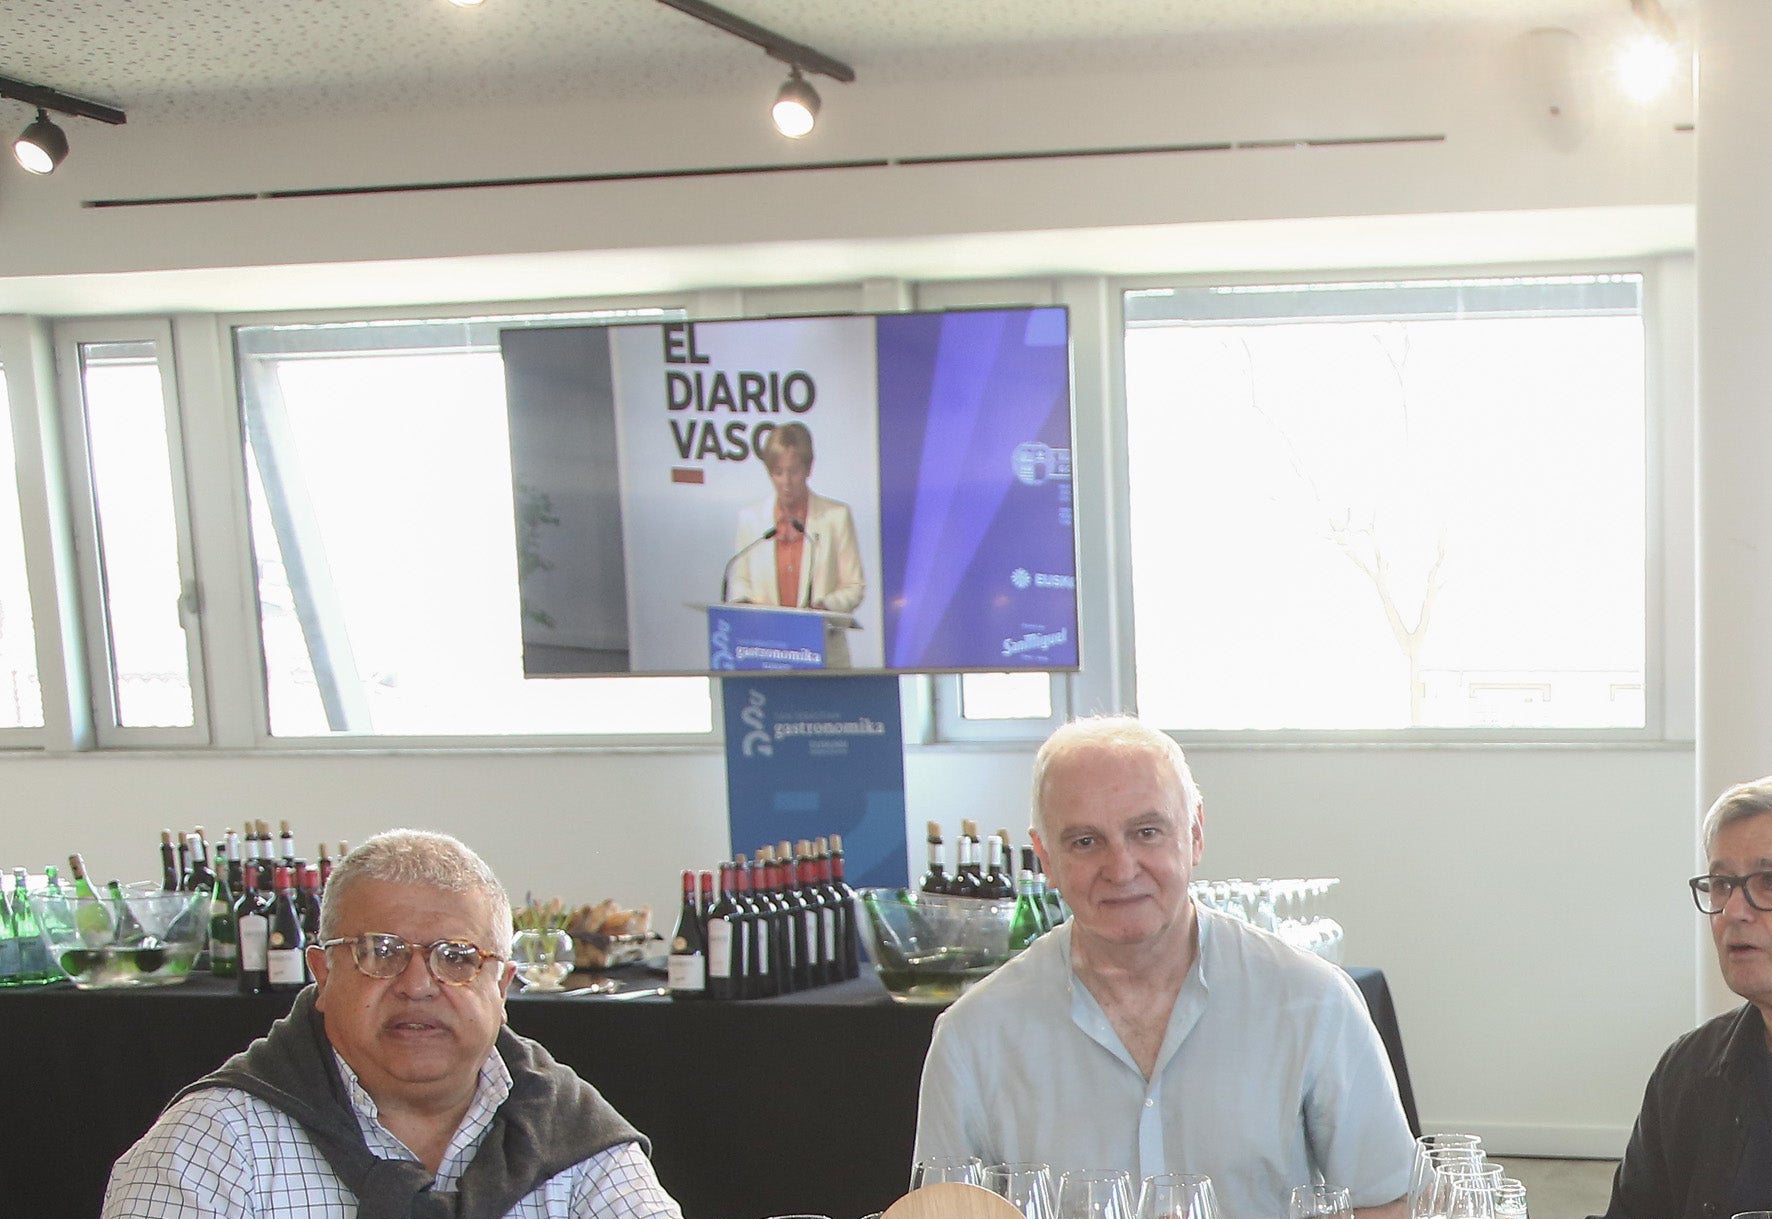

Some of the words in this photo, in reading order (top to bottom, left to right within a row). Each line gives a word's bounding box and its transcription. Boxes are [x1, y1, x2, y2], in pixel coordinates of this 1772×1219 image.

[664, 323, 709, 364] EL
[666, 371, 816, 413] DIARIO
[669, 420, 777, 461] VASC
[774, 717, 886, 740] gastronomika
